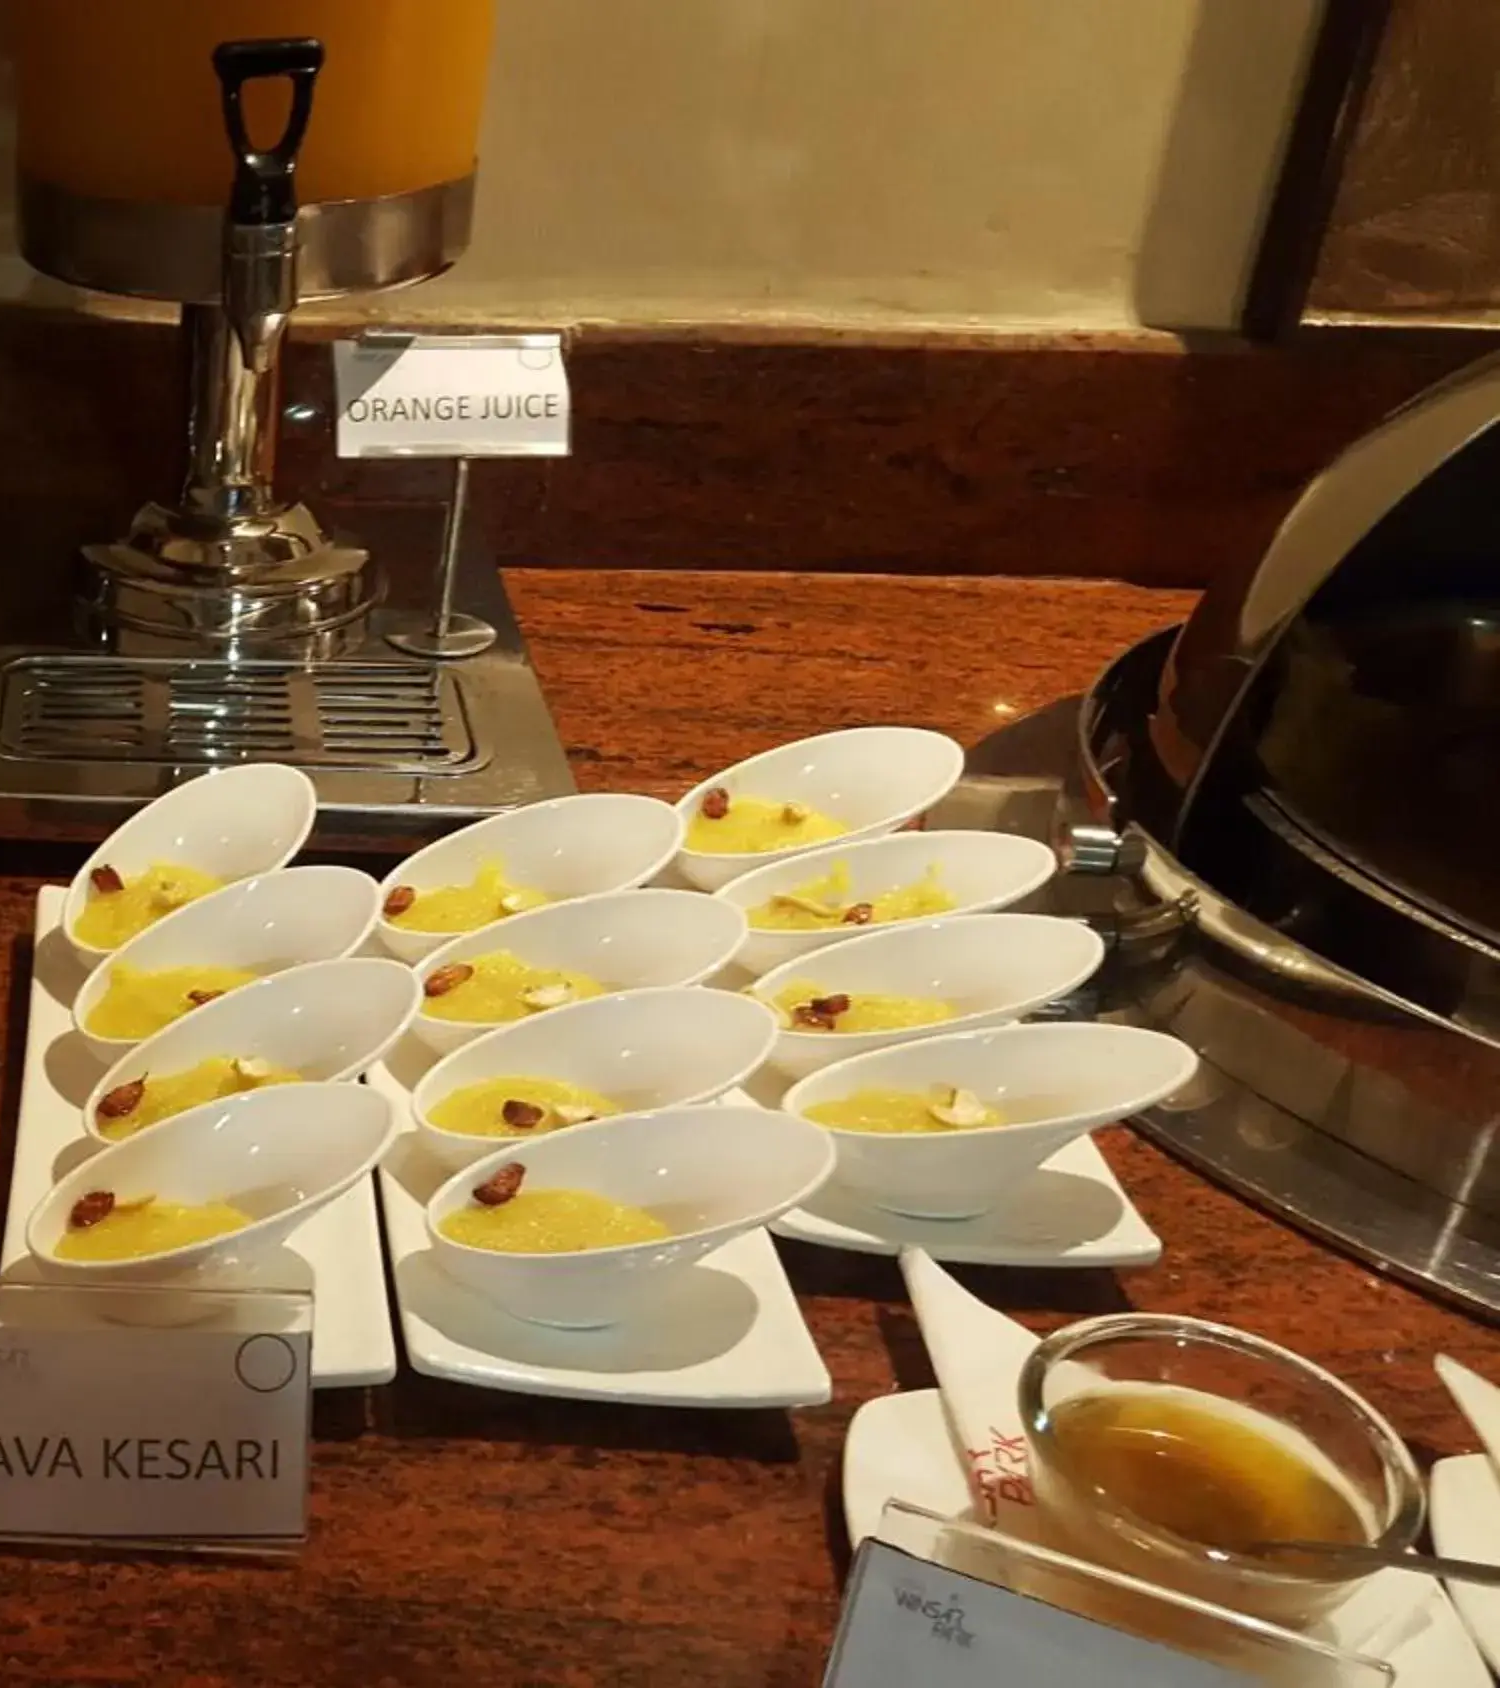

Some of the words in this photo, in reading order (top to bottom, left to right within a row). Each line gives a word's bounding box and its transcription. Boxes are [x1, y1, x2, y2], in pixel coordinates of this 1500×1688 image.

[347, 395, 471, 422] ORANGE
[480, 393, 560, 419] JUICE
[103, 1438, 280, 1480] KESARI
